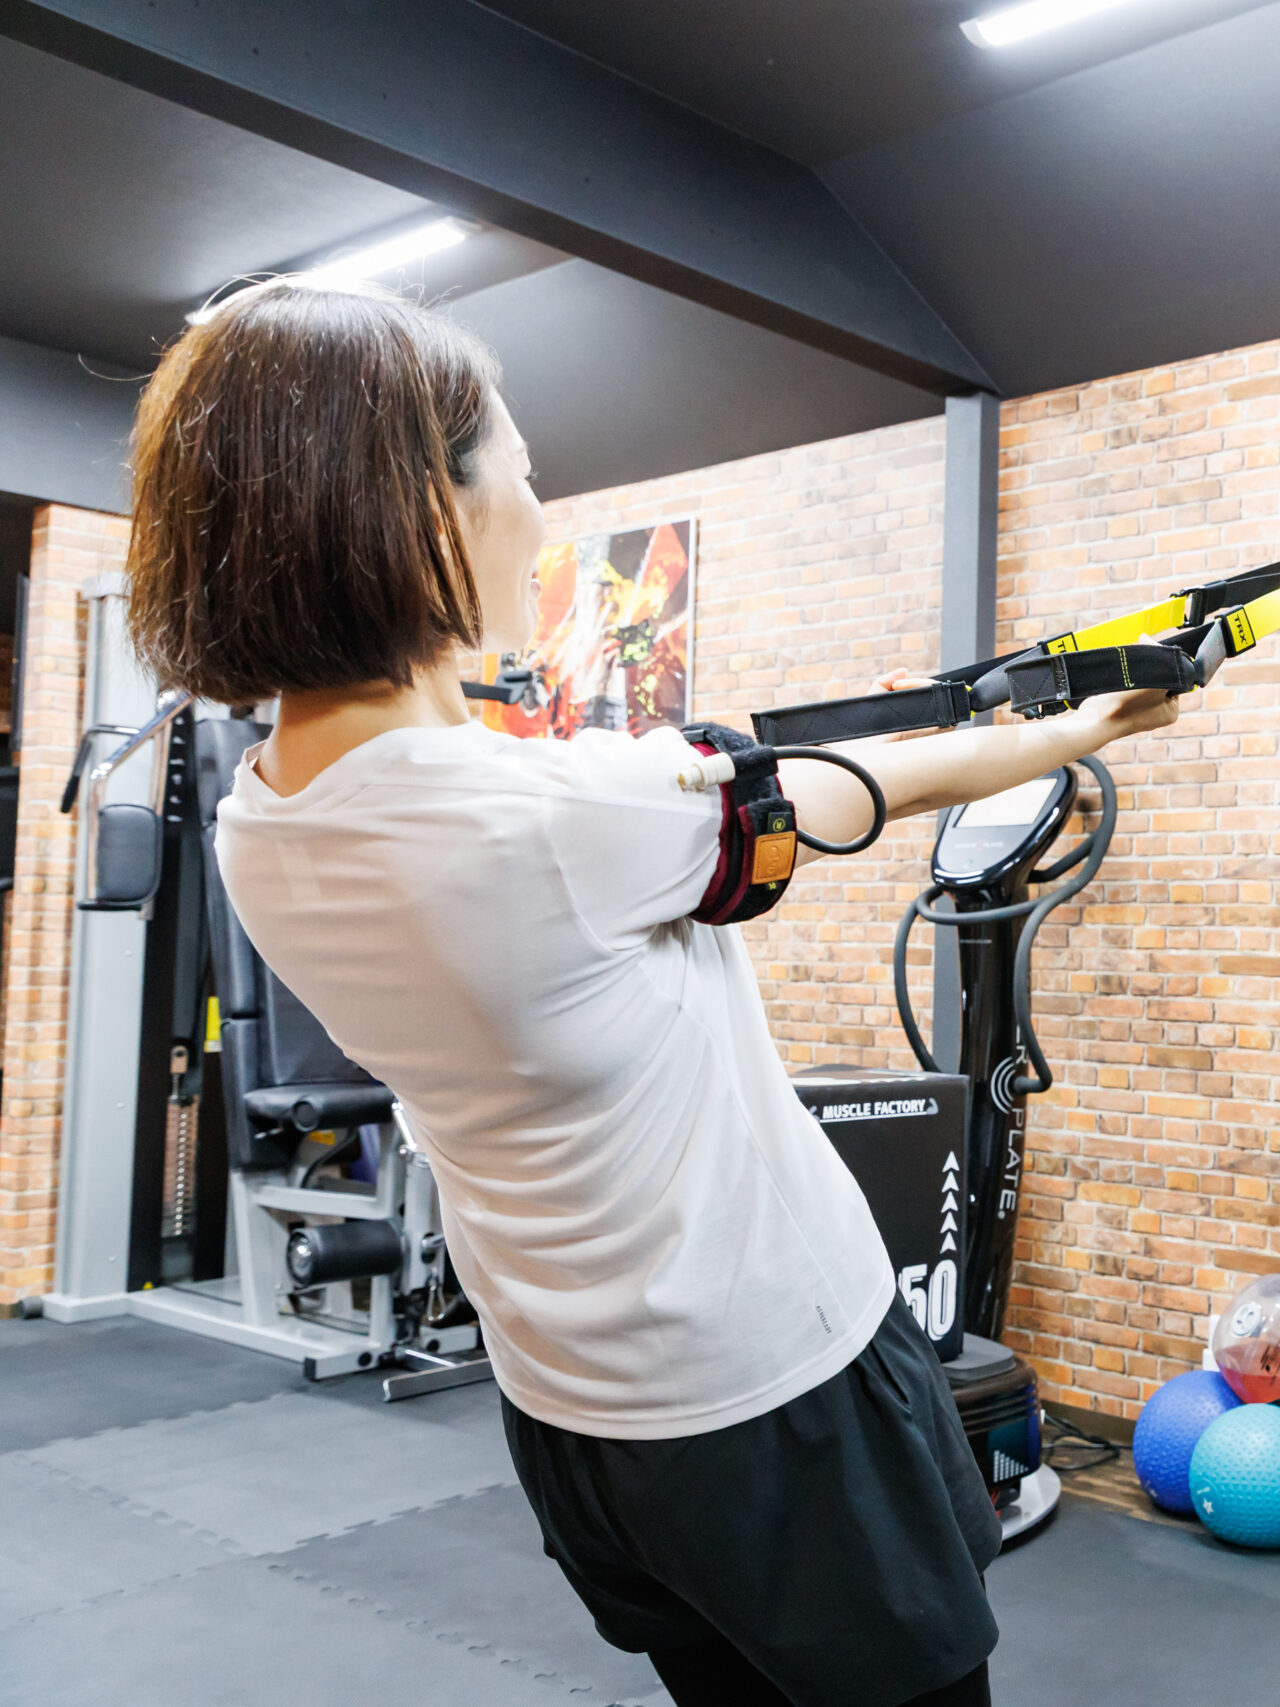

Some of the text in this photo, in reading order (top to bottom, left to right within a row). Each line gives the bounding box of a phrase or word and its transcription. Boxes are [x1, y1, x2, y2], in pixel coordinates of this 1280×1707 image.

[1234, 613, 1247, 644] TRX
[822, 1099, 926, 1119] MUSCLE FACTORY
